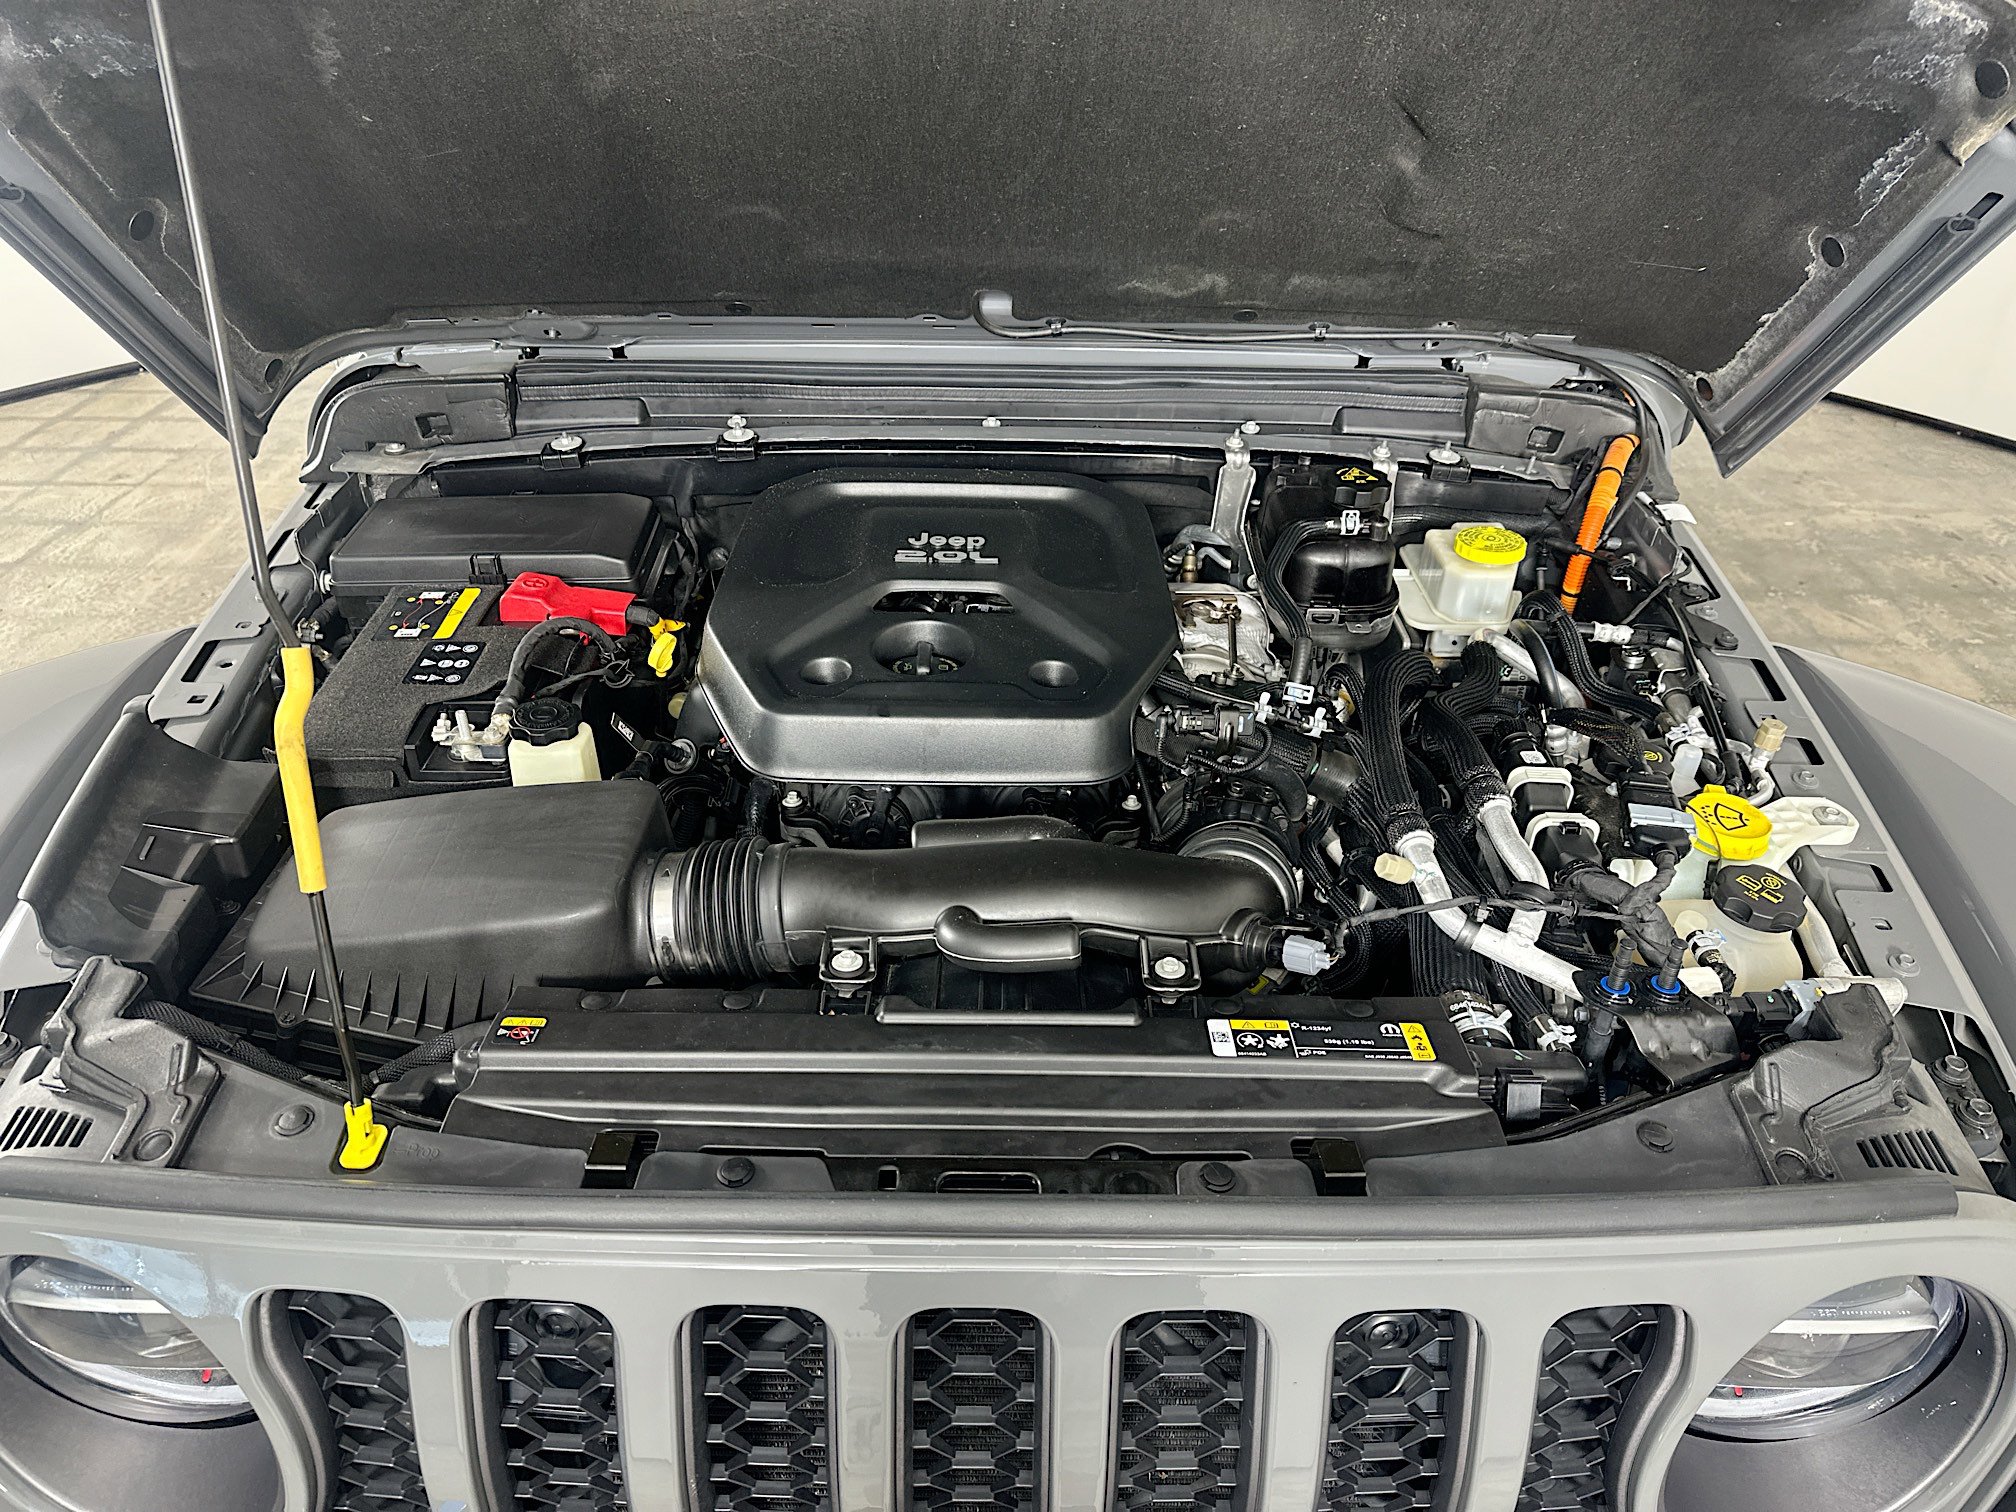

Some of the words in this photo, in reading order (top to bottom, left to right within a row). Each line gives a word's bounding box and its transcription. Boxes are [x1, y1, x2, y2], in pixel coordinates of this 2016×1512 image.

[907, 532, 986, 552] Jeep
[894, 549, 999, 565] 2.0L
[407, 1142, 441, 1162] Prop
